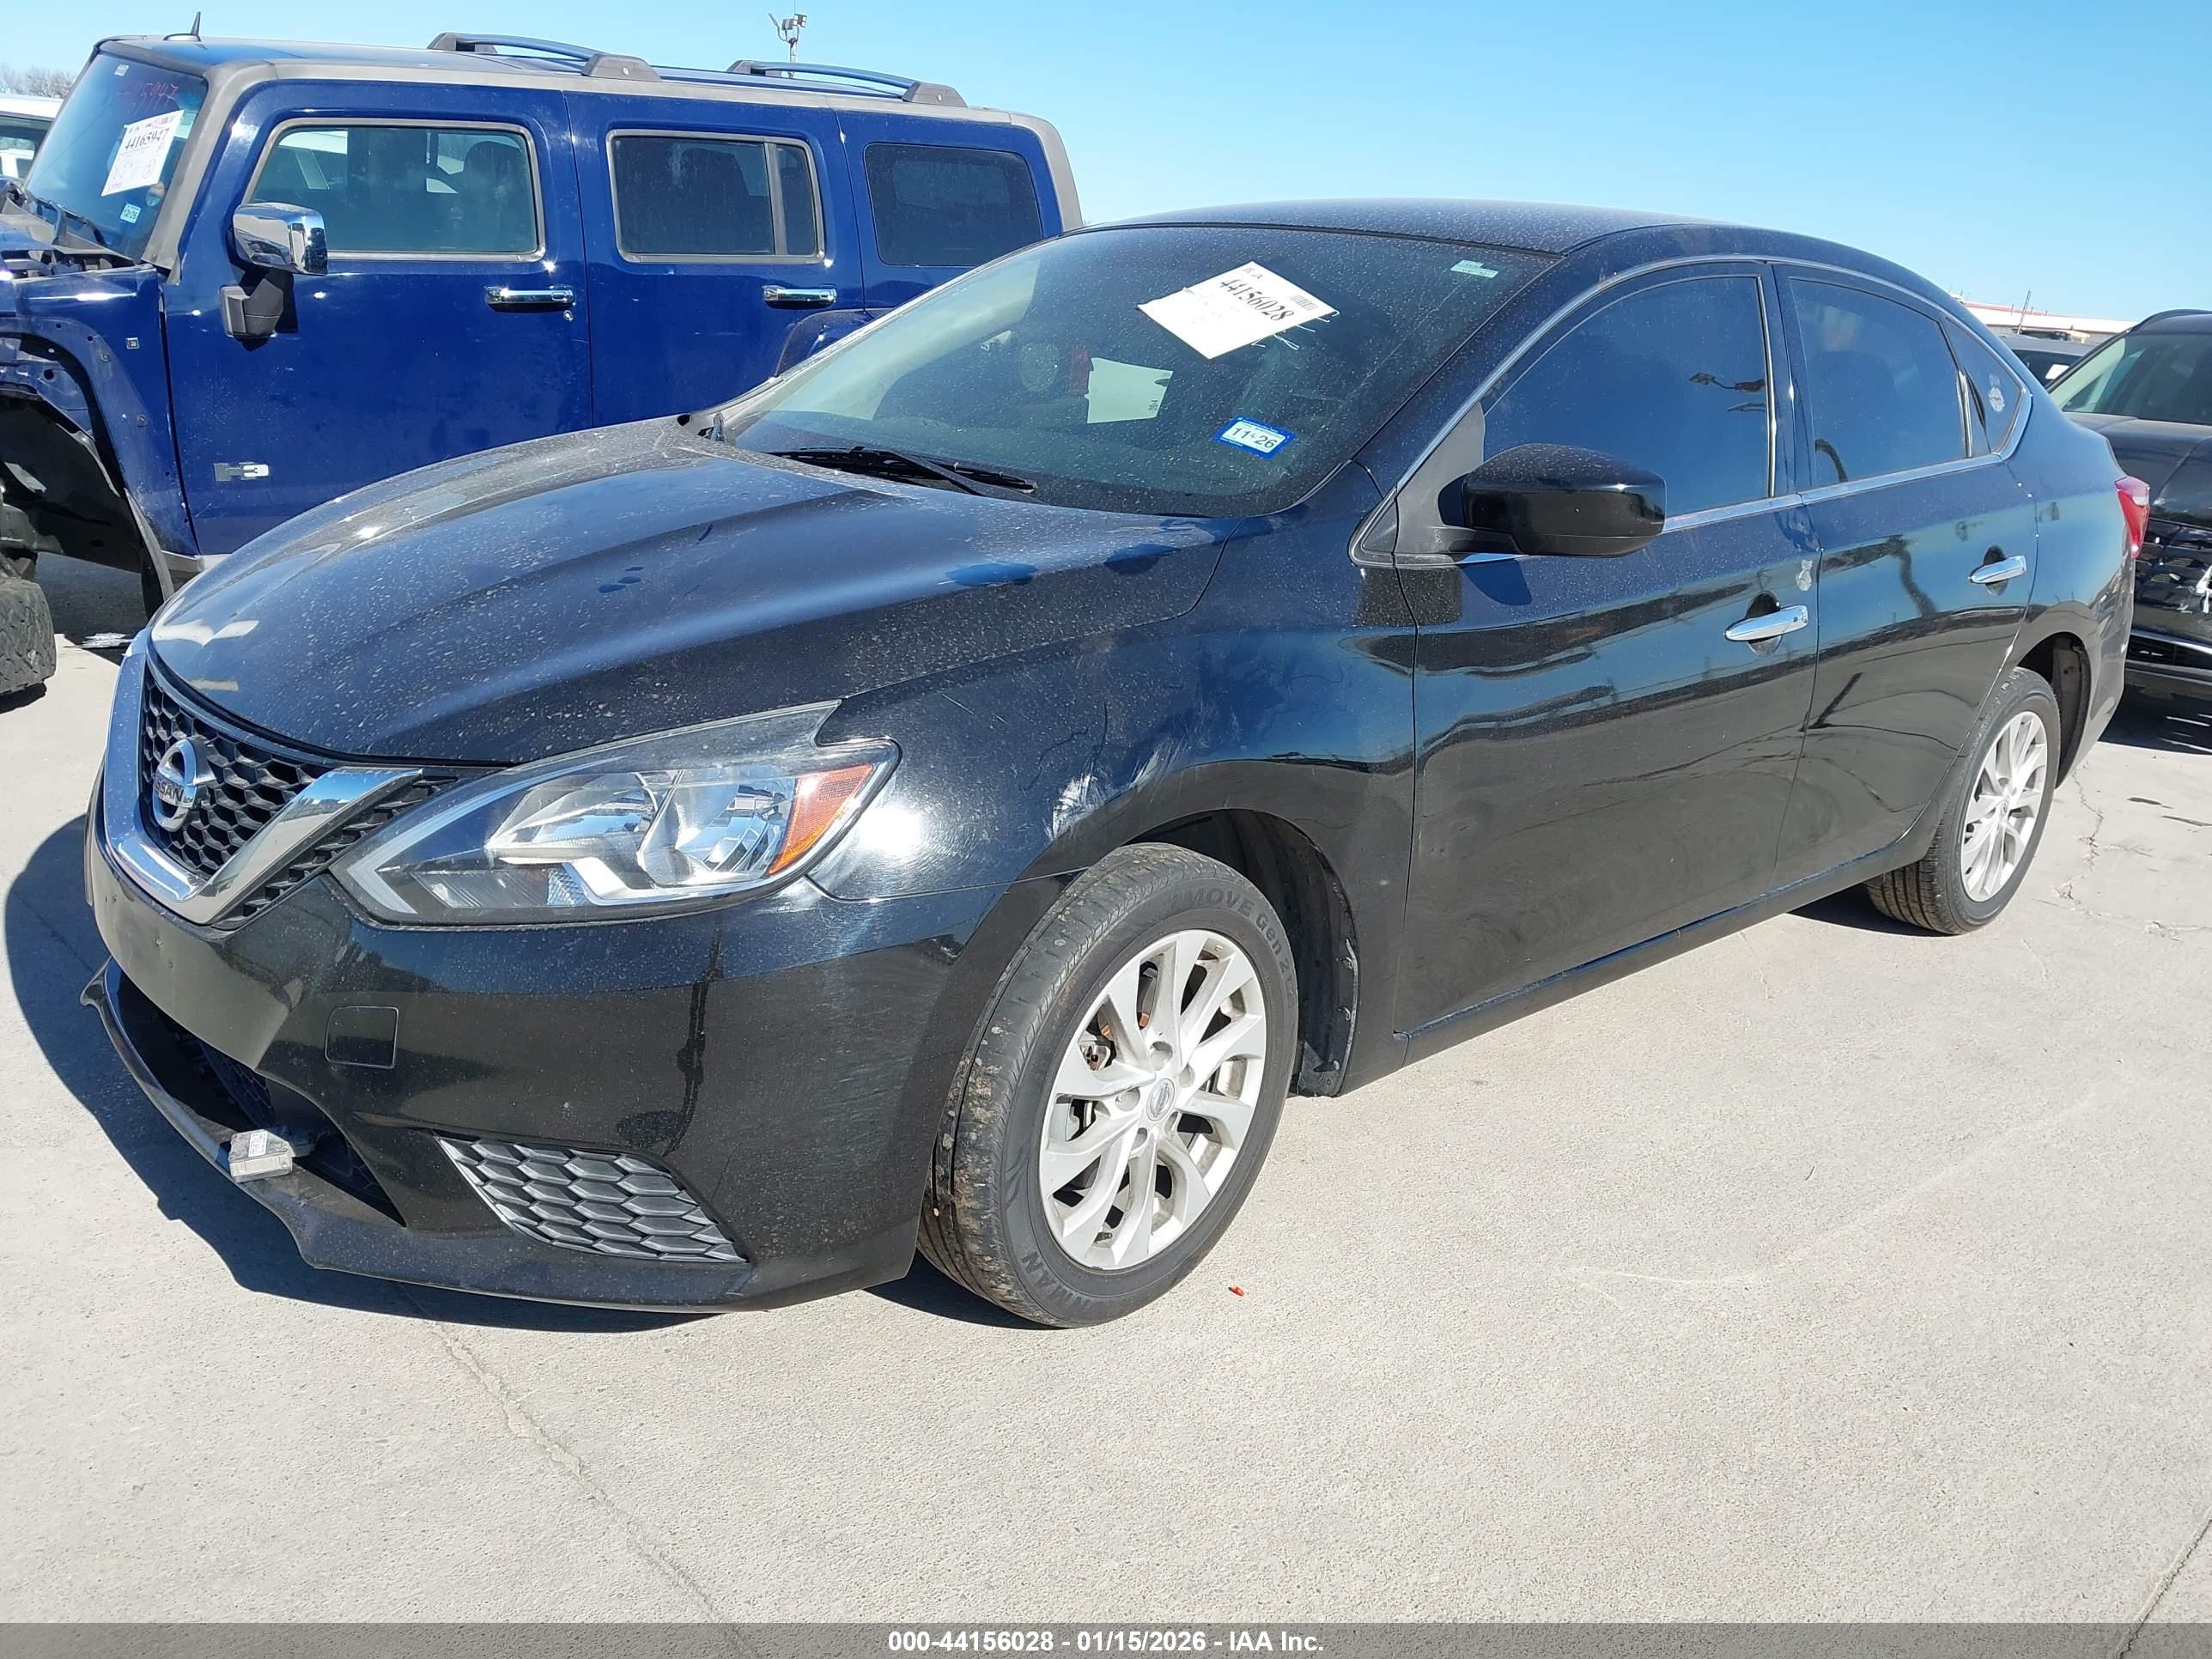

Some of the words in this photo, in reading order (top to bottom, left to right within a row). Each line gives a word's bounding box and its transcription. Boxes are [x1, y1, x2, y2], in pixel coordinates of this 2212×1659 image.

[1219, 278, 1295, 321] 44156028
[1255, 912, 1283, 956] Gen
[1279, 957, 1291, 974] 2
